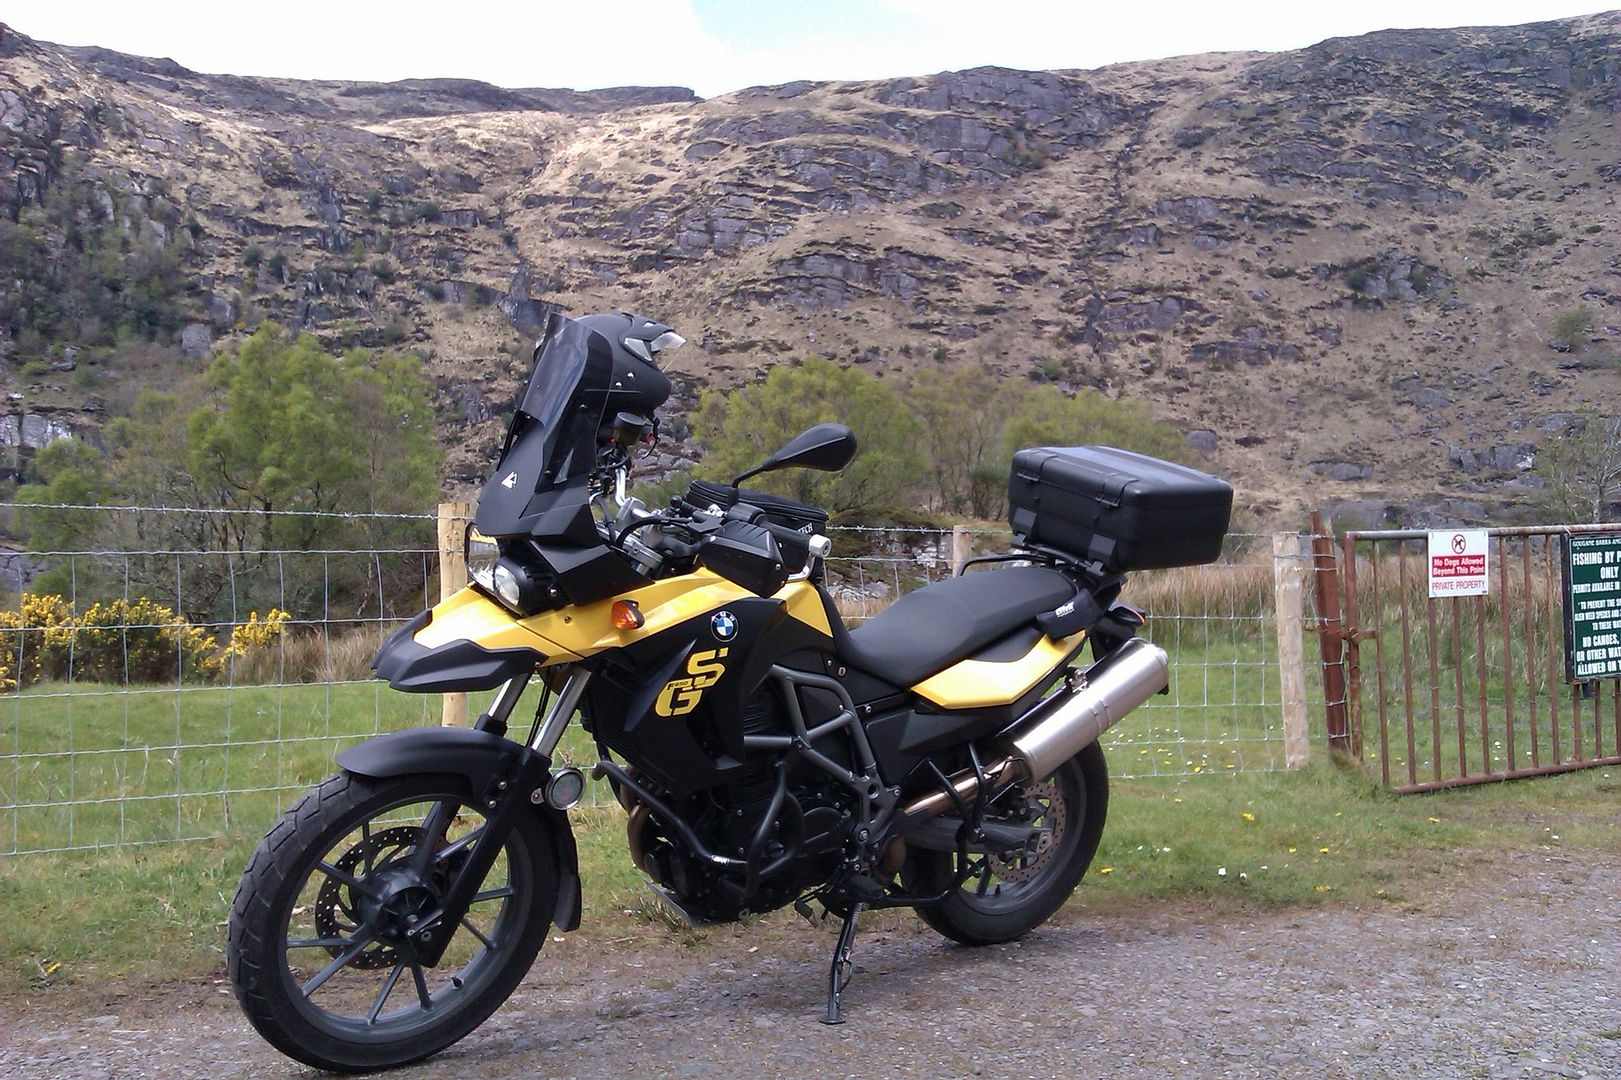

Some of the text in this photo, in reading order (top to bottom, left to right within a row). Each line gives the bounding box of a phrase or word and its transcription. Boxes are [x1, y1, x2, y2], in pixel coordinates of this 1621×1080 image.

[1434, 557, 1484, 567] No Dogs Allowed
[1572, 551, 1603, 566] FISHING
[1605, 551, 1615, 563] BY
[1433, 566, 1484, 576] Beyond This Point
[1600, 566, 1619, 579] ONLY
[1432, 580, 1485, 591] PRIVATE PROPERTY
[1582, 635, 1591, 648] NO
[1576, 650, 1585, 662] OR
[1586, 648, 1606, 661] OTHER
[1577, 661, 1606, 676] ALLOWED
[1607, 660, 1617, 672] ON
